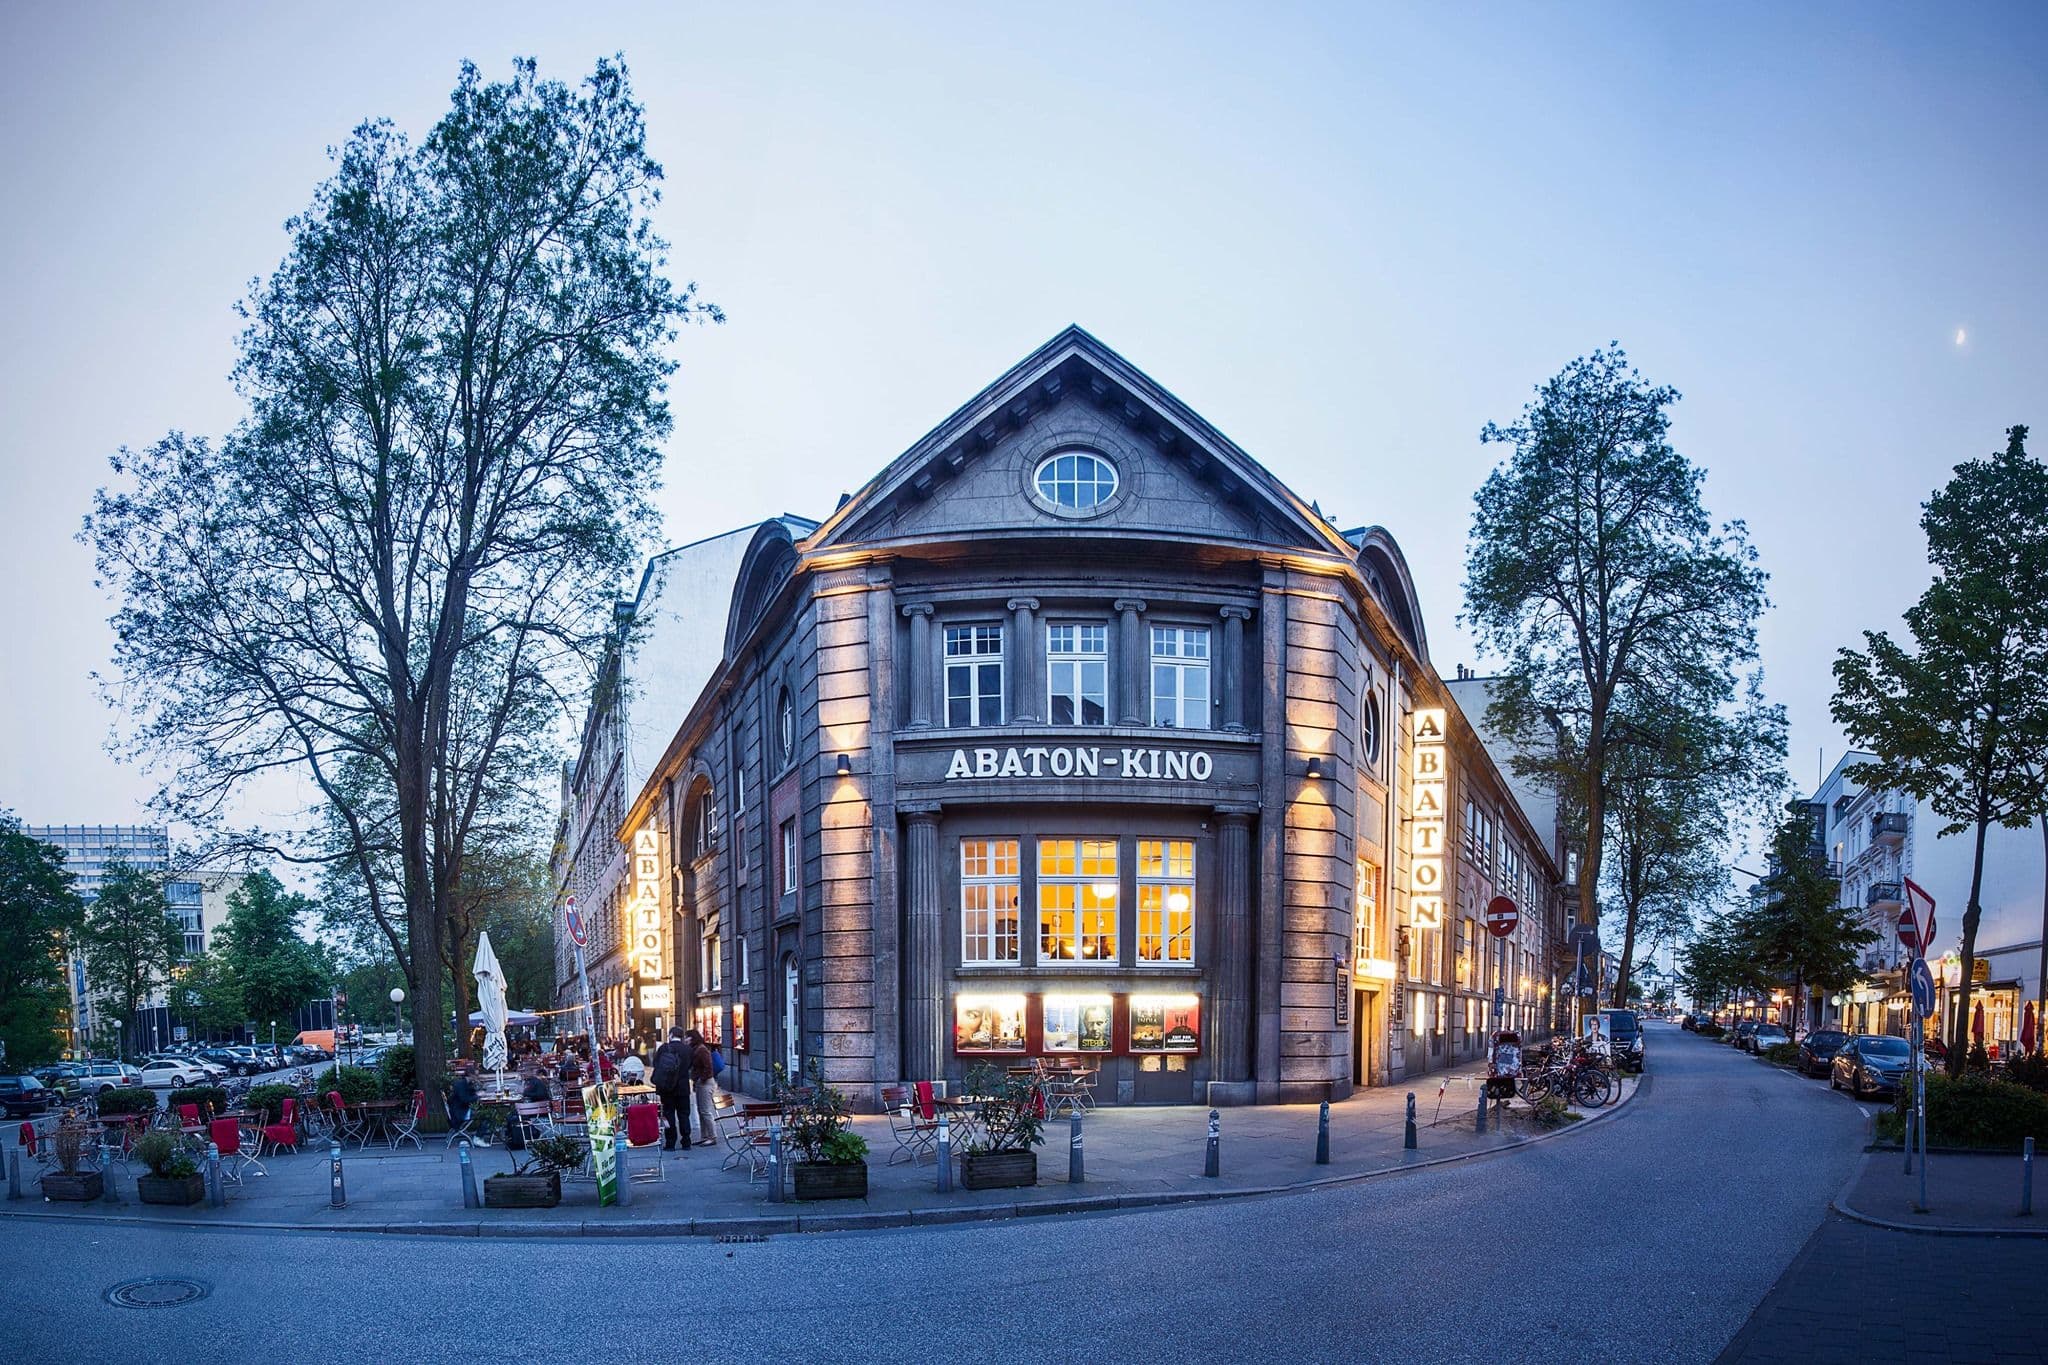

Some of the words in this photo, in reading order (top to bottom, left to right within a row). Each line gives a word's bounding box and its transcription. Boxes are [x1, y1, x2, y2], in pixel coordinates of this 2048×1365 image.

[945, 747, 1213, 780] ABATON-KINO
[1414, 714, 1441, 923] ABATON
[640, 834, 658, 974] ABATON
